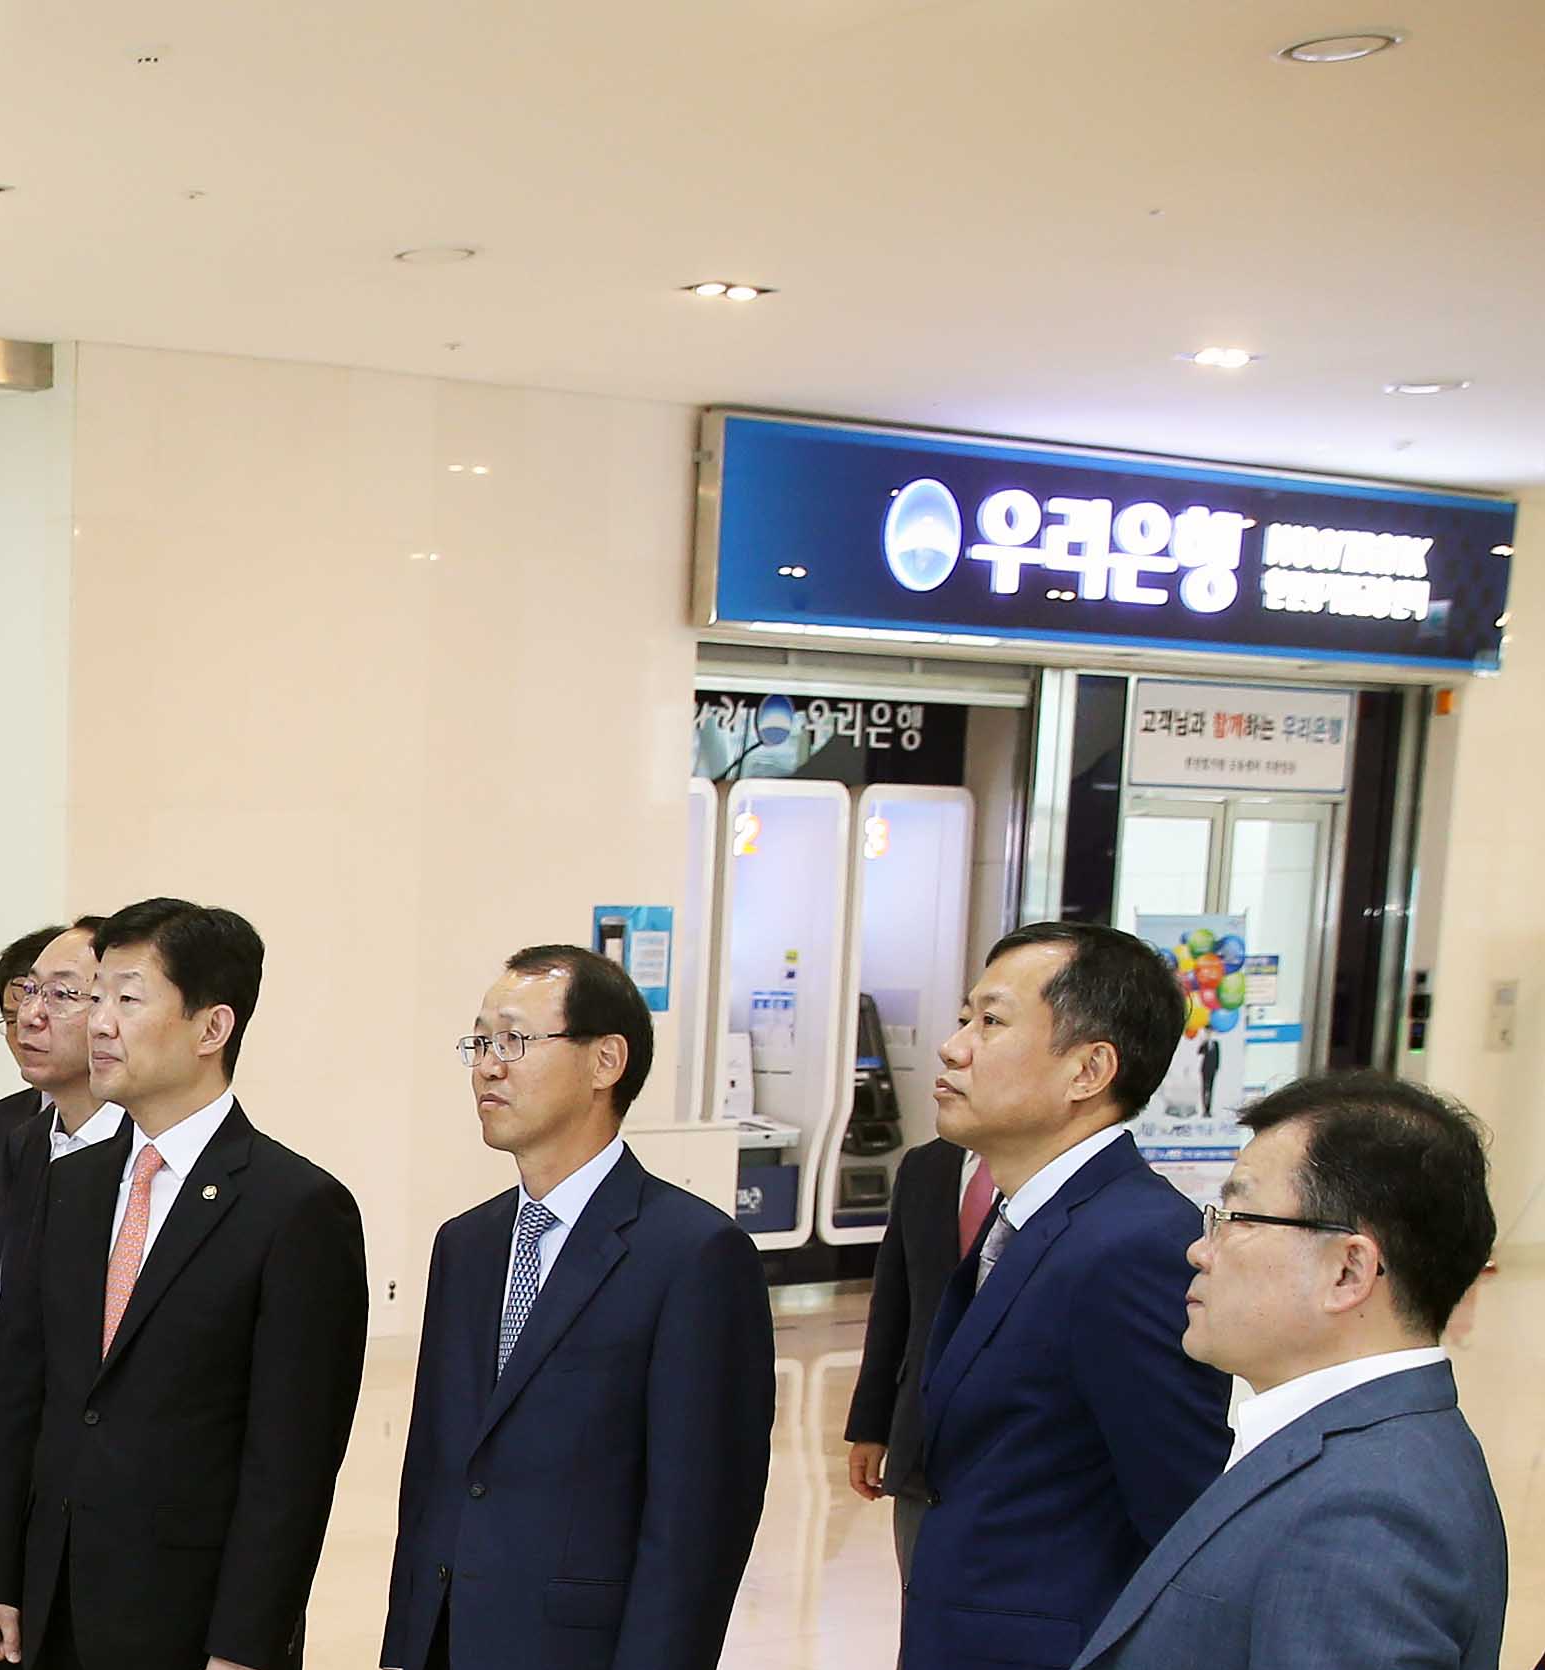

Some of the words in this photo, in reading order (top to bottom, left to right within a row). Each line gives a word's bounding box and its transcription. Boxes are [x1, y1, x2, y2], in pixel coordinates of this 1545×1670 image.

[965, 489, 1245, 613] 우리은행
[805, 699, 925, 751] 우리은행
[1140, 709, 1206, 737] 고객님과
[1211, 711, 1276, 741] 함께하는
[1281, 715, 1343, 745] 우리은행
[733, 812, 762, 857] 2
[864, 816, 891, 860] 3
